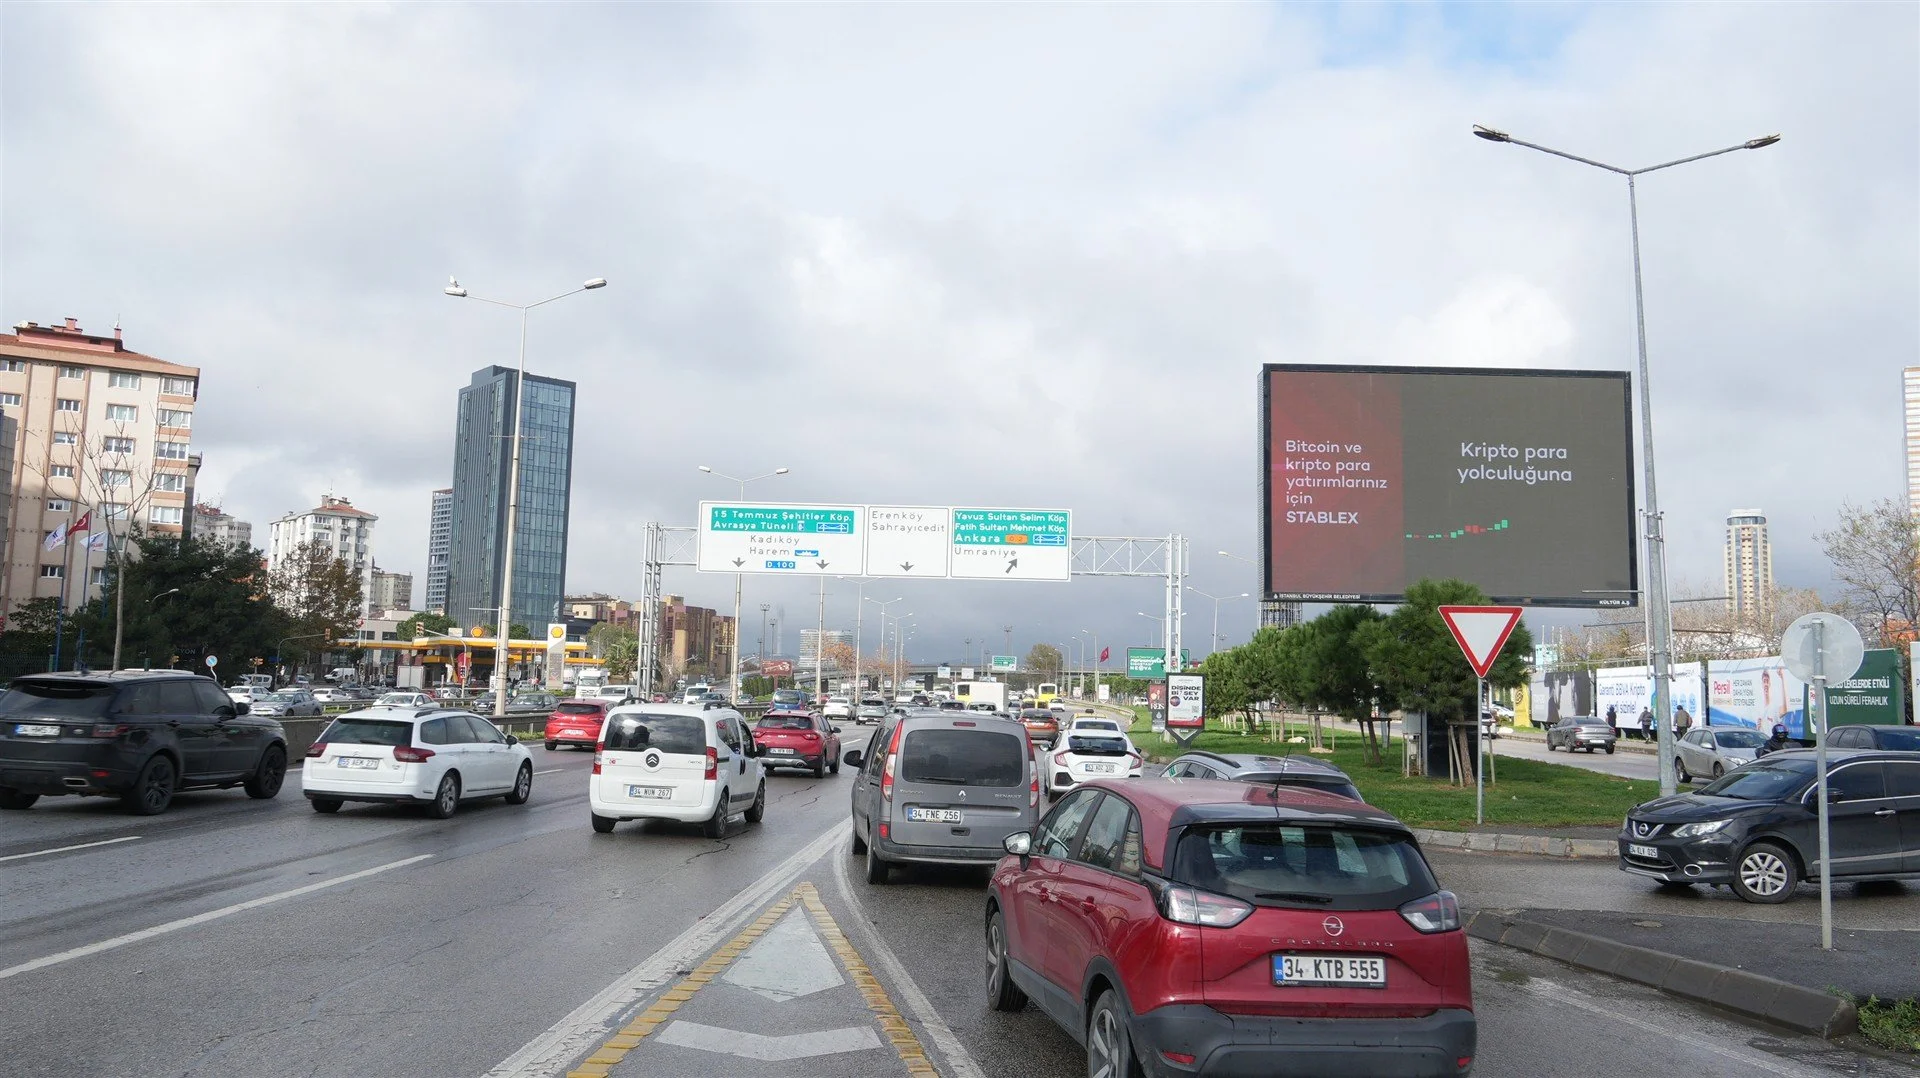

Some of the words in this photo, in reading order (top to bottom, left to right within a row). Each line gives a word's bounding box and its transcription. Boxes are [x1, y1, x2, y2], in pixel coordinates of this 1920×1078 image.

[1286, 440, 1340, 453] Bitcoin
[1344, 444, 1362, 453] ve
[1461, 442, 1519, 462] Kripto
[1525, 447, 1567, 462] para
[1286, 457, 1331, 473] kripto
[1336, 462, 1370, 474] para
[1457, 464, 1572, 485] yolculuğuna
[1286, 476, 1388, 490] yatırımlarınız
[1286, 491, 1313, 507] için
[714, 510, 727, 518] 15
[733, 511, 778, 519] Temmuz
[782, 511, 825, 521] Şehitler
[829, 513, 852, 523] Köp.
[872, 511, 923, 521] Erenköy
[955, 513, 984, 521] Yavuz
[987, 513, 1017, 521] Sultan
[1019, 513, 1045, 522] Selim
[1048, 514, 1067, 524] Köp.
[1286, 511, 1359, 524] STABLEX
[713, 521, 756, 530] Avrasya
[761, 521, 794, 530] Tüneli
[872, 523, 945, 533] Sahrayıcedit
[955, 523, 977, 531] Fatih
[979, 523, 1007, 531] Sultan
[1009, 523, 1047, 532] Mehmet
[1048, 524, 1067, 533] Köp.
[750, 535, 800, 545] Kadıköy
[955, 533, 1000, 543] Ankara
[750, 547, 790, 555] Harem
[954, 545, 1017, 557] Ümraniye
[1713, 680, 1731, 695] Persil
[1829, 695, 1844, 705] UZUN
[912, 810, 922, 818] 34
[925, 811, 940, 819] FNE
[944, 811, 959, 820] 256
[1284, 958, 1304, 978] 34
[1313, 959, 1344, 979] KTB
[1349, 960, 1379, 980] 555
